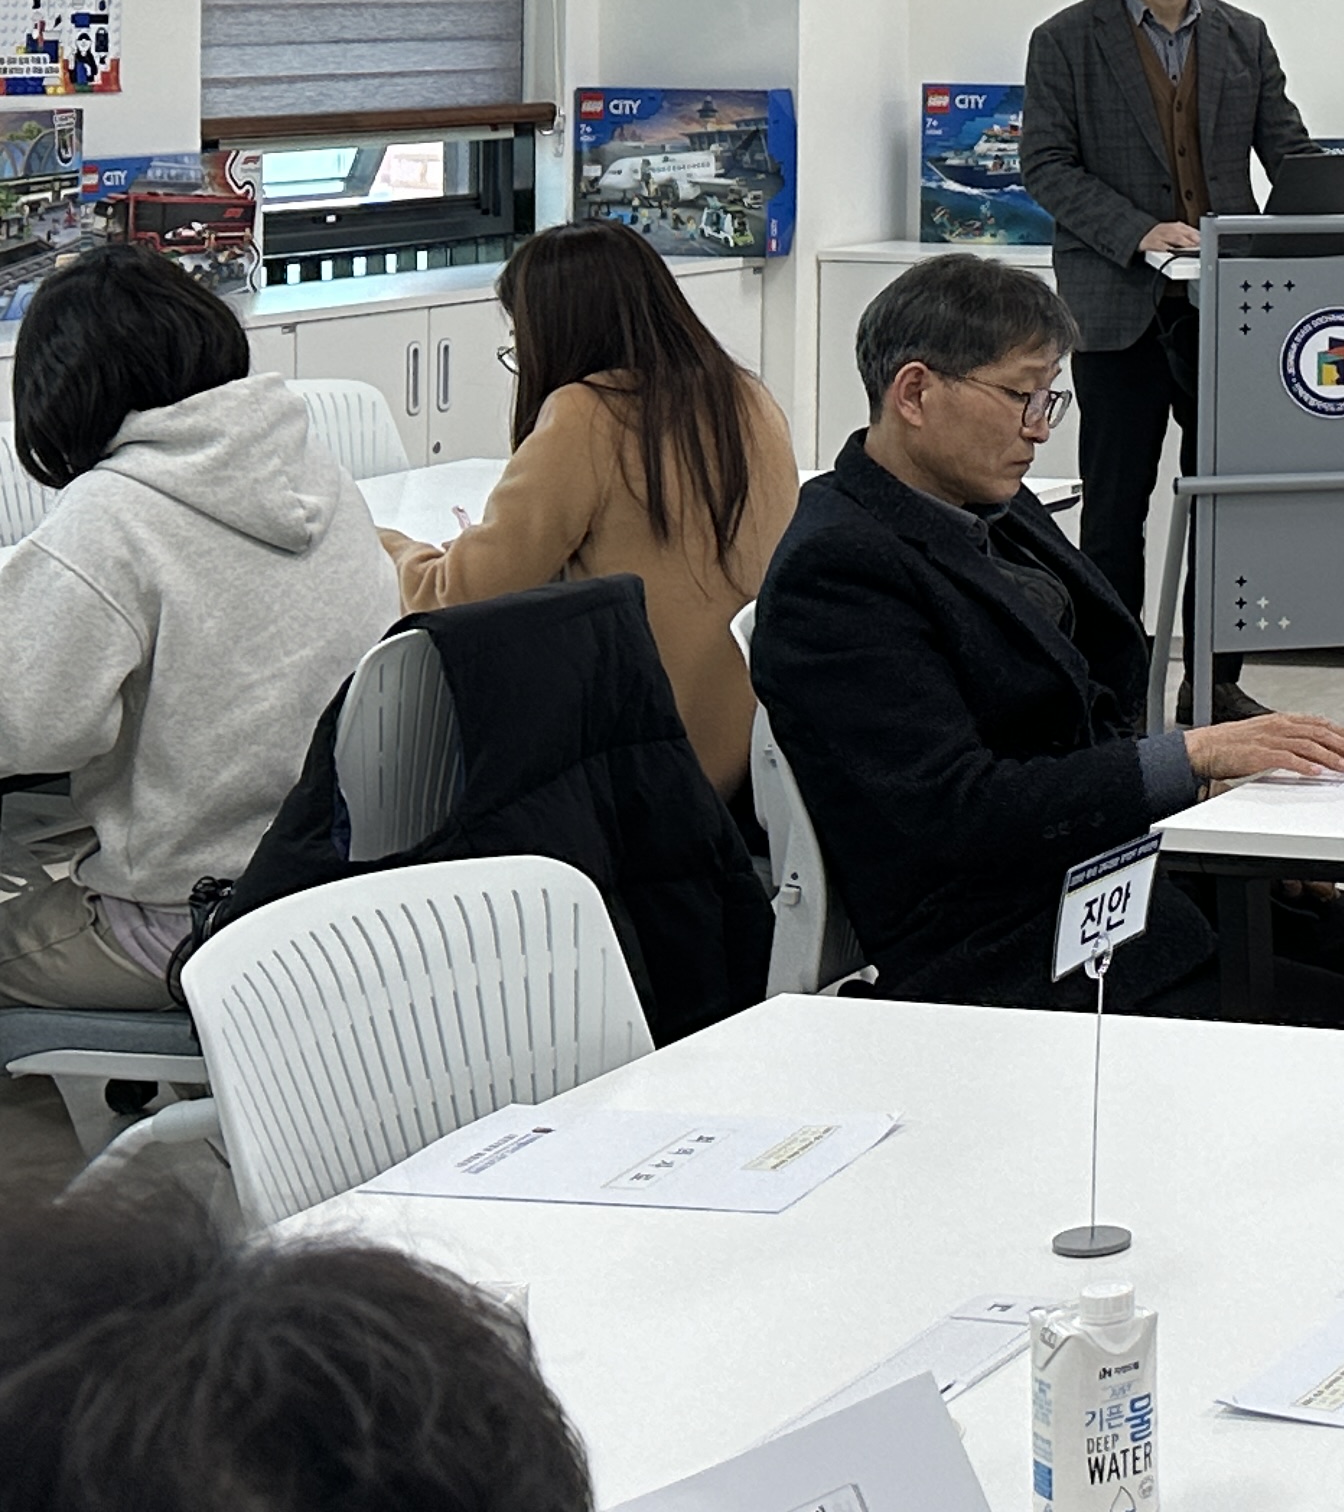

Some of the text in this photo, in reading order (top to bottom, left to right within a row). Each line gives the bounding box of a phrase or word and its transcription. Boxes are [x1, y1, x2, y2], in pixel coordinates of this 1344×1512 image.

[609, 99, 642, 115] CITY
[955, 94, 987, 109] CITY
[102, 169, 128, 186] CITY
[1080, 880, 1132, 945] 진안
[1086, 1433, 1119, 1455] DEEP
[1087, 1441, 1153, 1485] WATER
